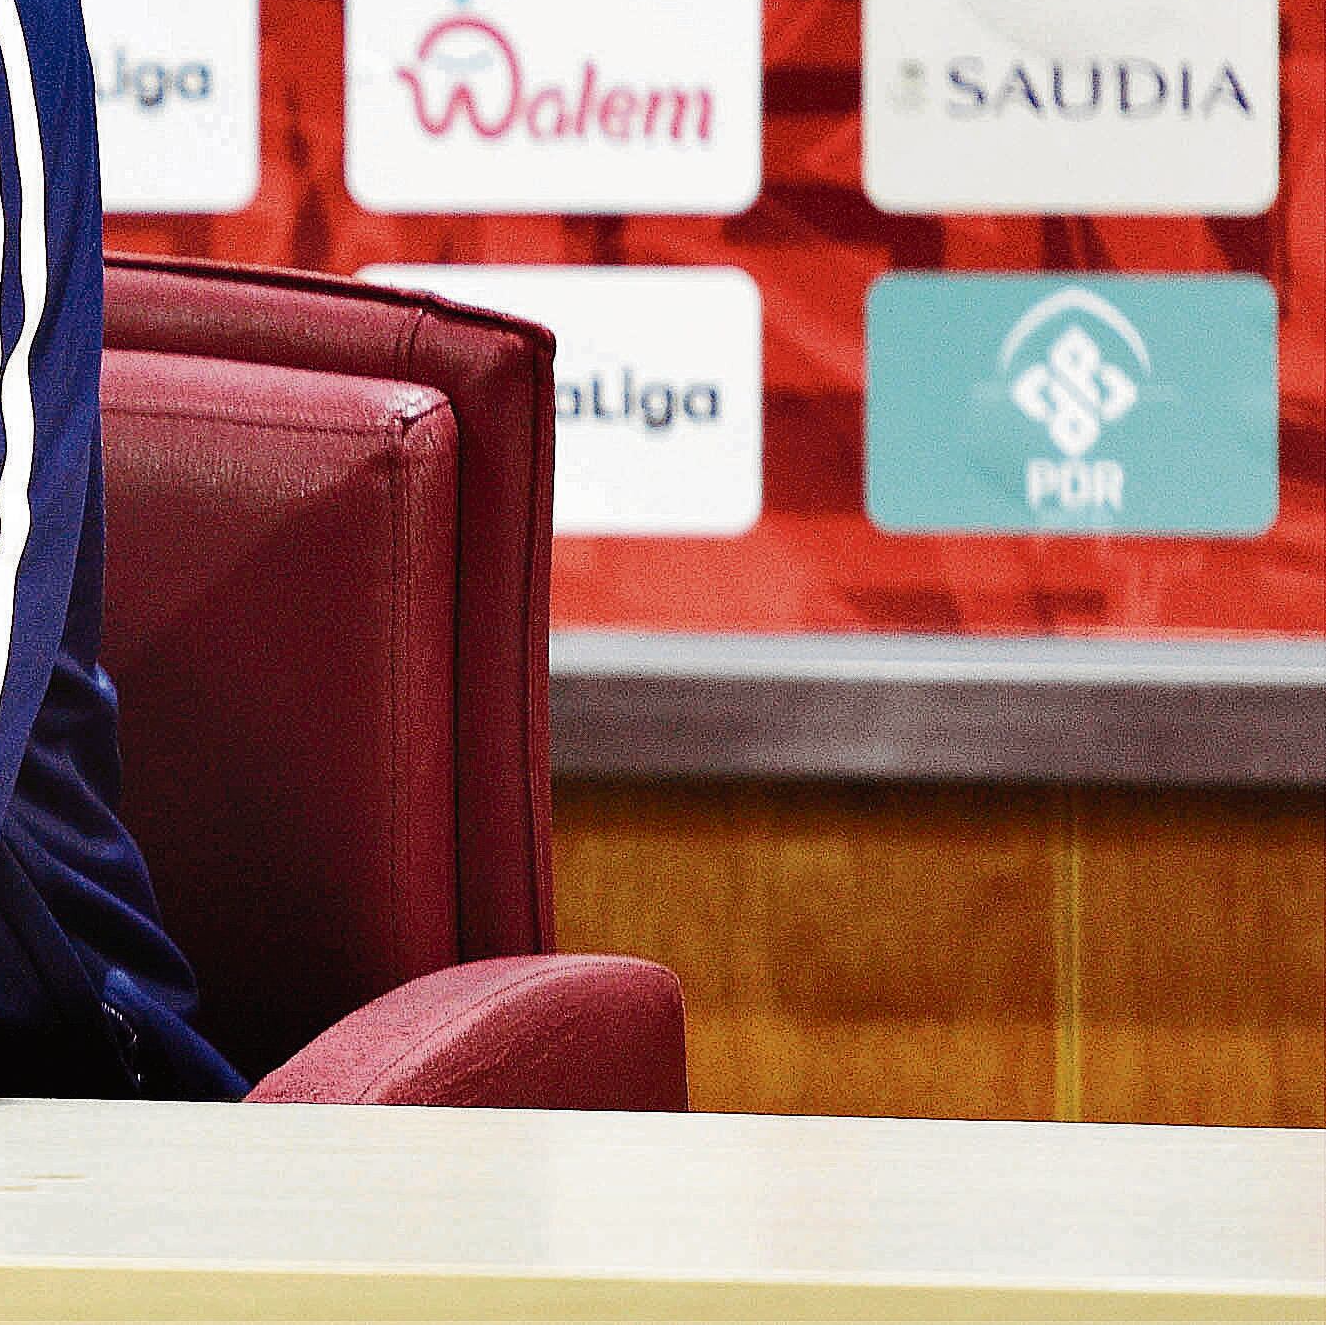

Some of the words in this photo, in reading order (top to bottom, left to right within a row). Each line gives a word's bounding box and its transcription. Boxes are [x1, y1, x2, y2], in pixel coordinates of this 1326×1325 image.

[396, 16, 715, 142] Walem
[947, 60, 1253, 118] SAUDIA
[556, 366, 722, 432] aLiga
